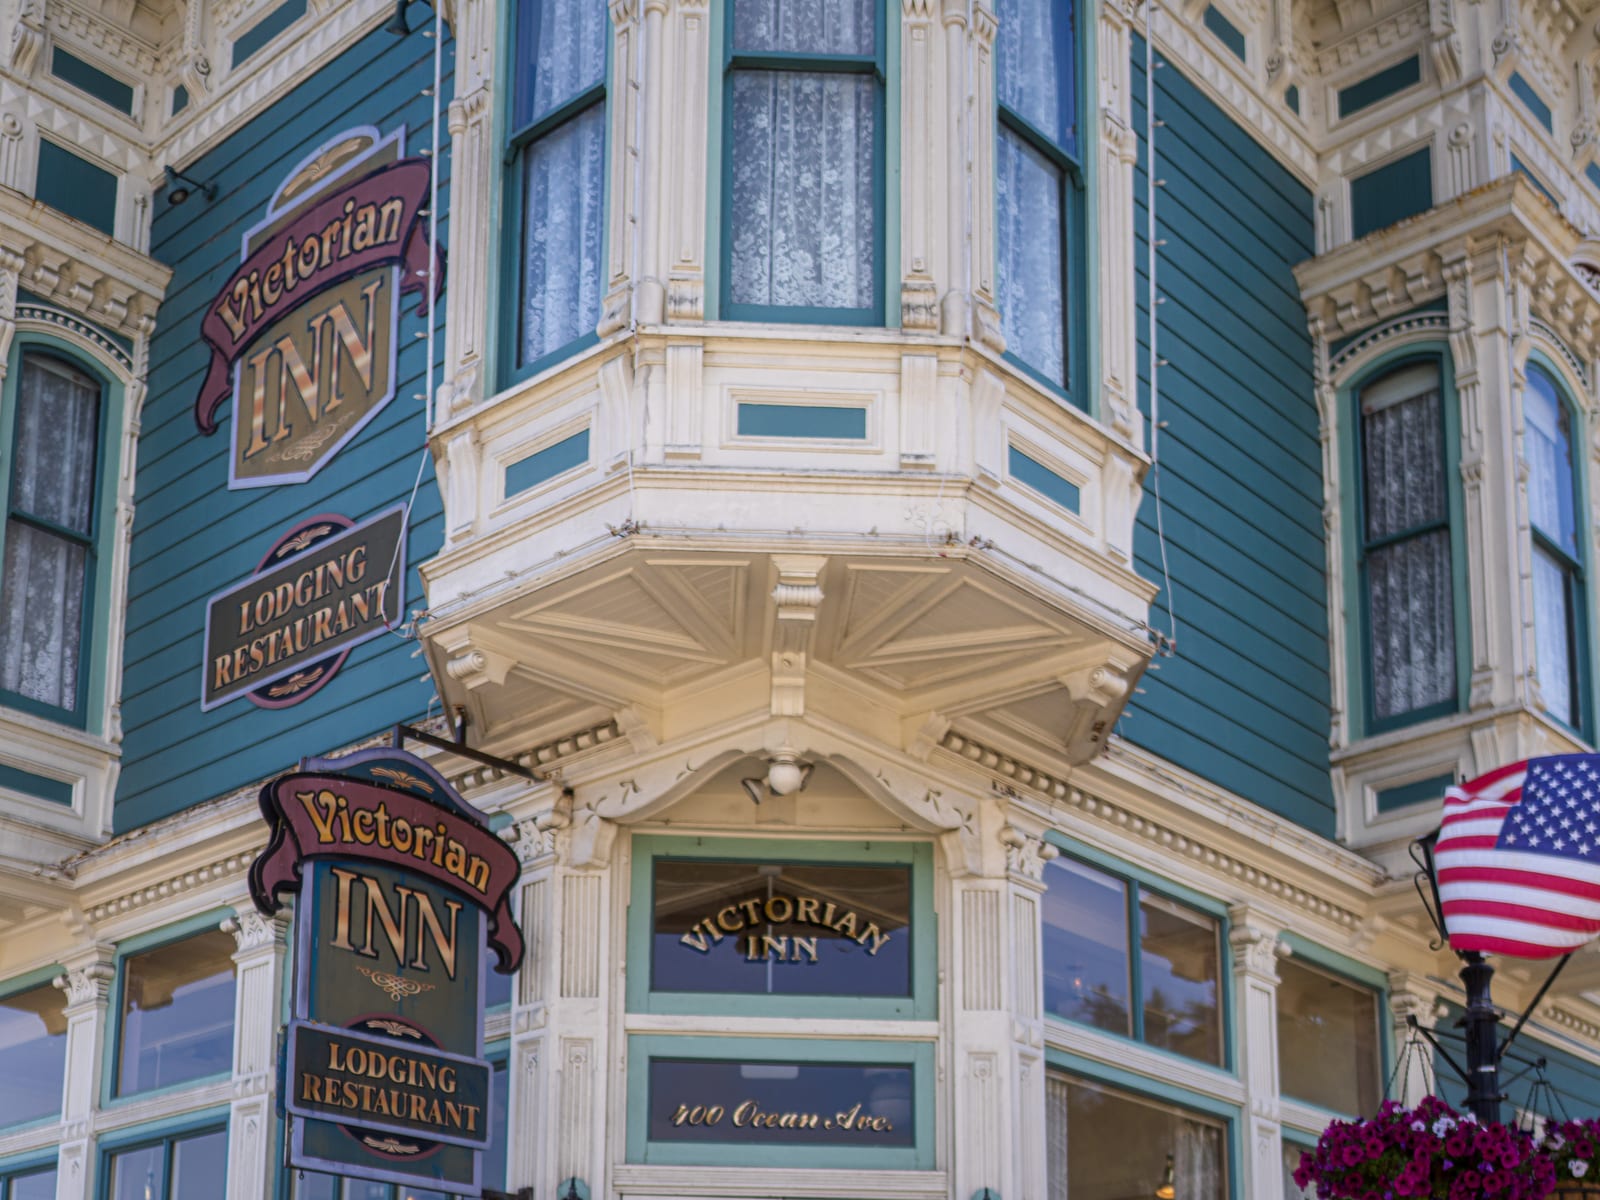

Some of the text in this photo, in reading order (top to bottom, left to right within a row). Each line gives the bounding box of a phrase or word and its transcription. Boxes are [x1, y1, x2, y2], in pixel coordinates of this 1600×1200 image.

[216, 196, 404, 343] Victorian
[243, 275, 383, 463] INN
[213, 579, 390, 690] RESTAURANT
[238, 543, 367, 636] LODGING
[295, 788, 492, 895] Victorian
[330, 865, 463, 980] INN
[679, 896, 891, 957] VICTORIAN
[746, 935, 819, 962] INN
[302, 1072, 481, 1132] RESTAURANT
[328, 1042, 457, 1094] LODGING
[671, 1100, 894, 1132] 400 Ocean Ave.
